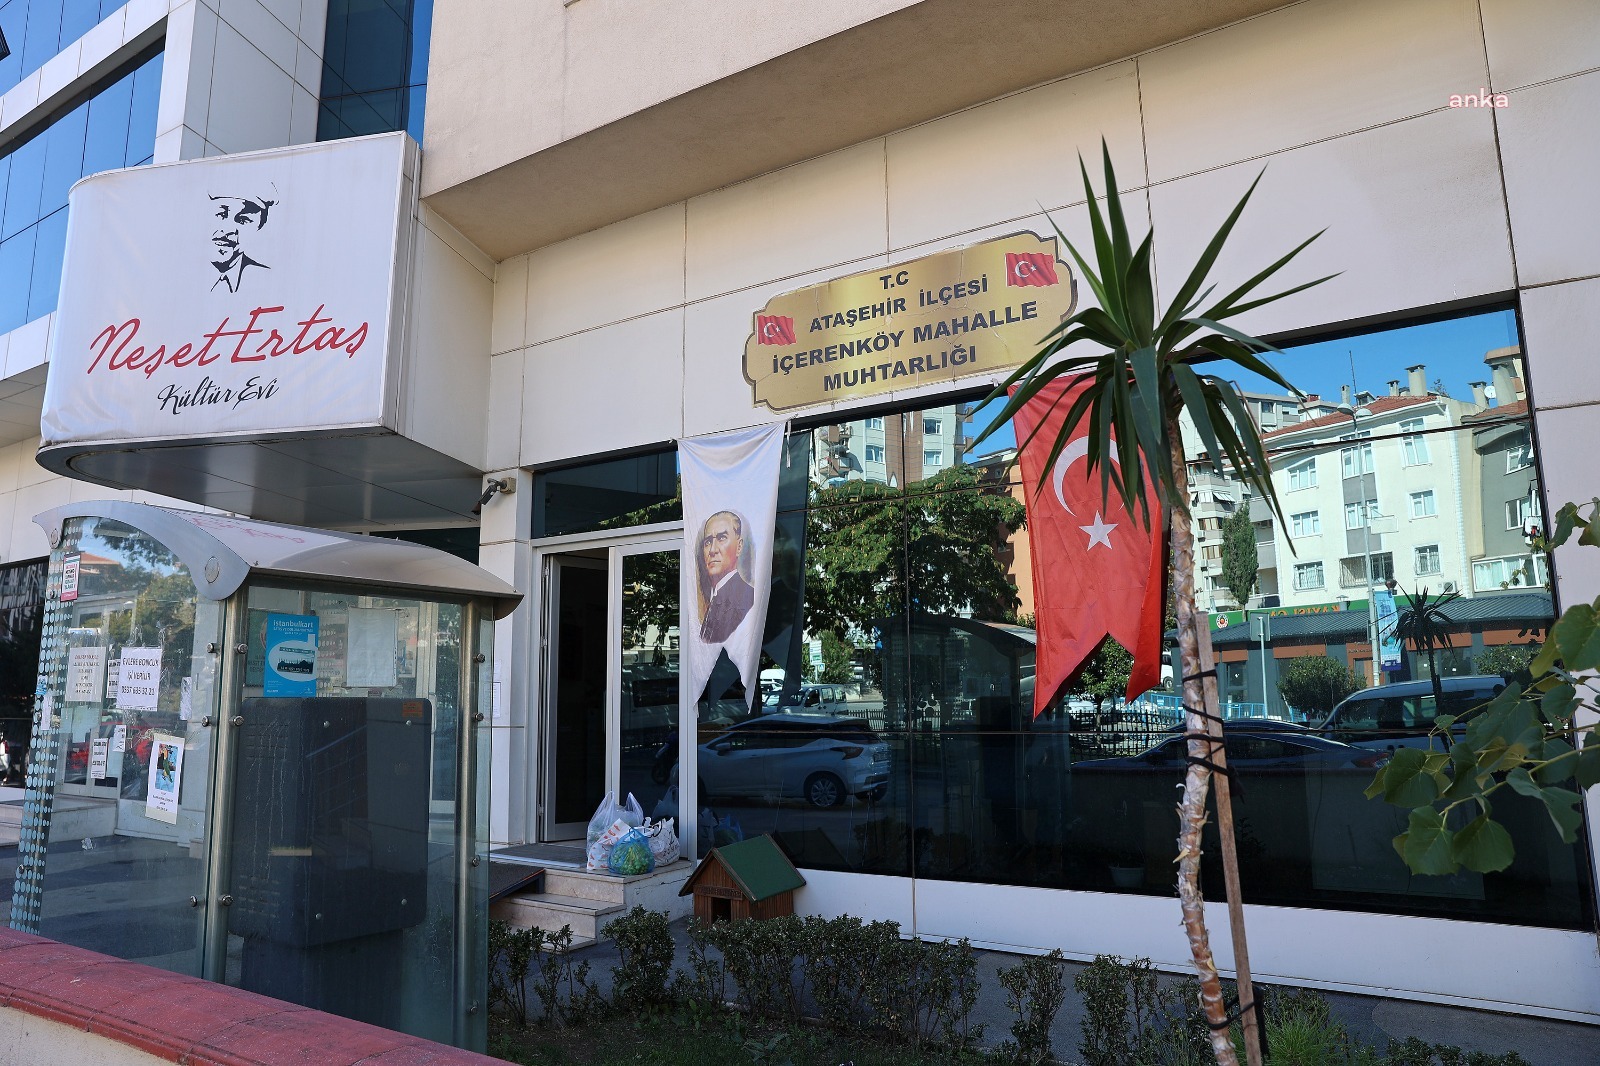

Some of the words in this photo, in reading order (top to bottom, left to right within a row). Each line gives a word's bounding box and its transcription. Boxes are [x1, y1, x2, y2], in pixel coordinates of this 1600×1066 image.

[809, 296, 907, 333] ATAŞEHİR
[919, 273, 988, 307] İLÇESİ
[879, 270, 909, 290] T.C
[87, 317, 230, 380] Neşet
[229, 304, 369, 364] Ertaş
[772, 330, 905, 376] İÇERENKÖY
[913, 300, 1038, 344] MAHALLE
[157, 376, 240, 415] Kültür
[231, 375, 280, 411] Evi
[823, 345, 977, 392] MUHTARLIĞI
